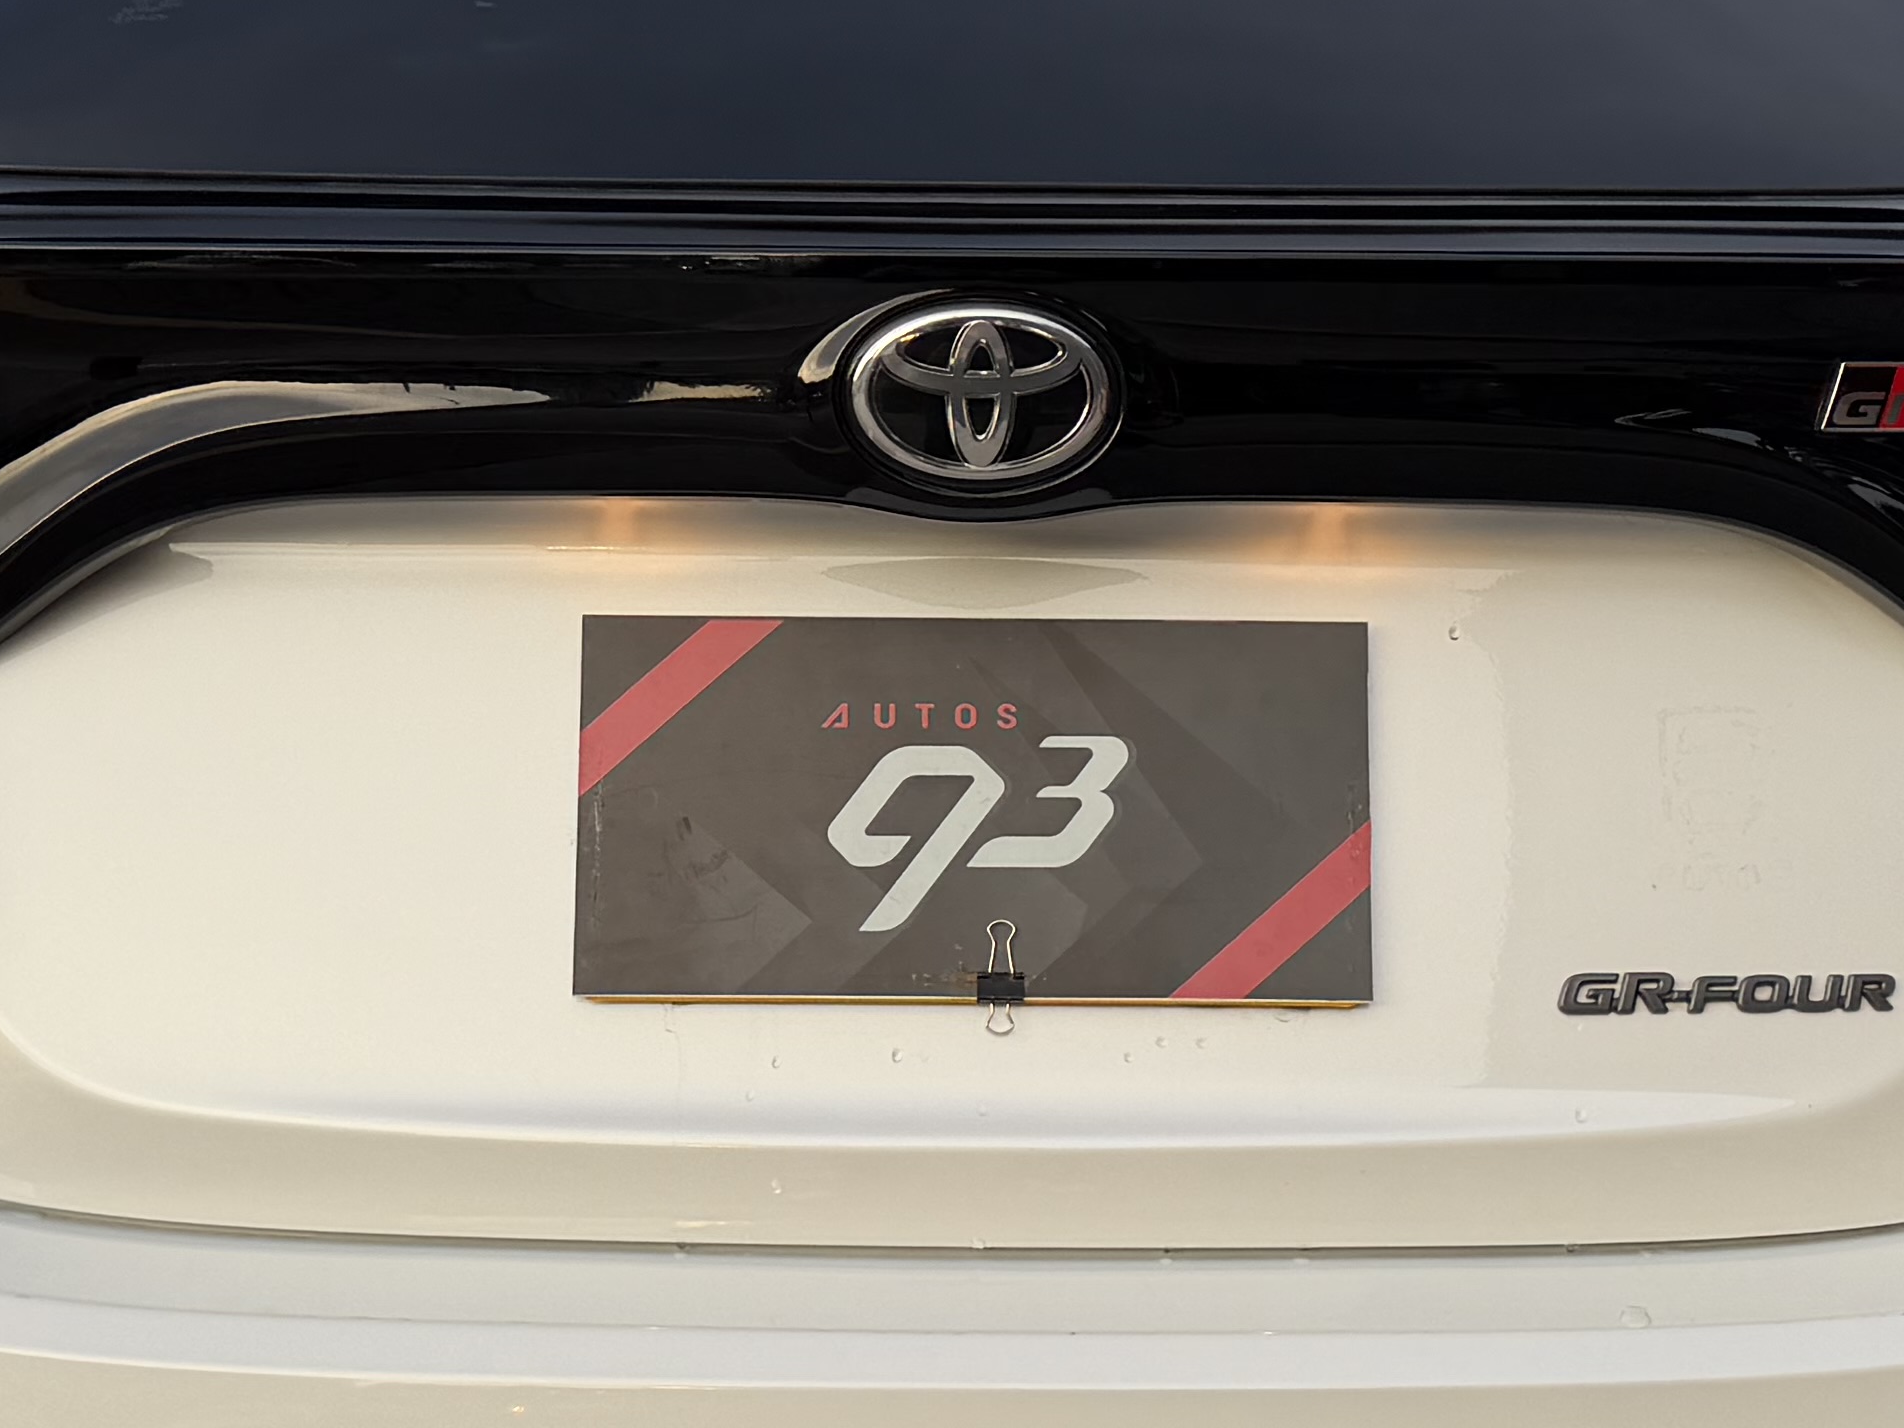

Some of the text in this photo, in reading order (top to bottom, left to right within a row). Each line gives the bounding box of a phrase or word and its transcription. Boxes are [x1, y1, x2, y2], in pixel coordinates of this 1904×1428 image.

[821, 702, 1019, 730] AUTOS
[826, 735, 1130, 932] 93
[1556, 971, 1897, 1015] GR-FOUR
